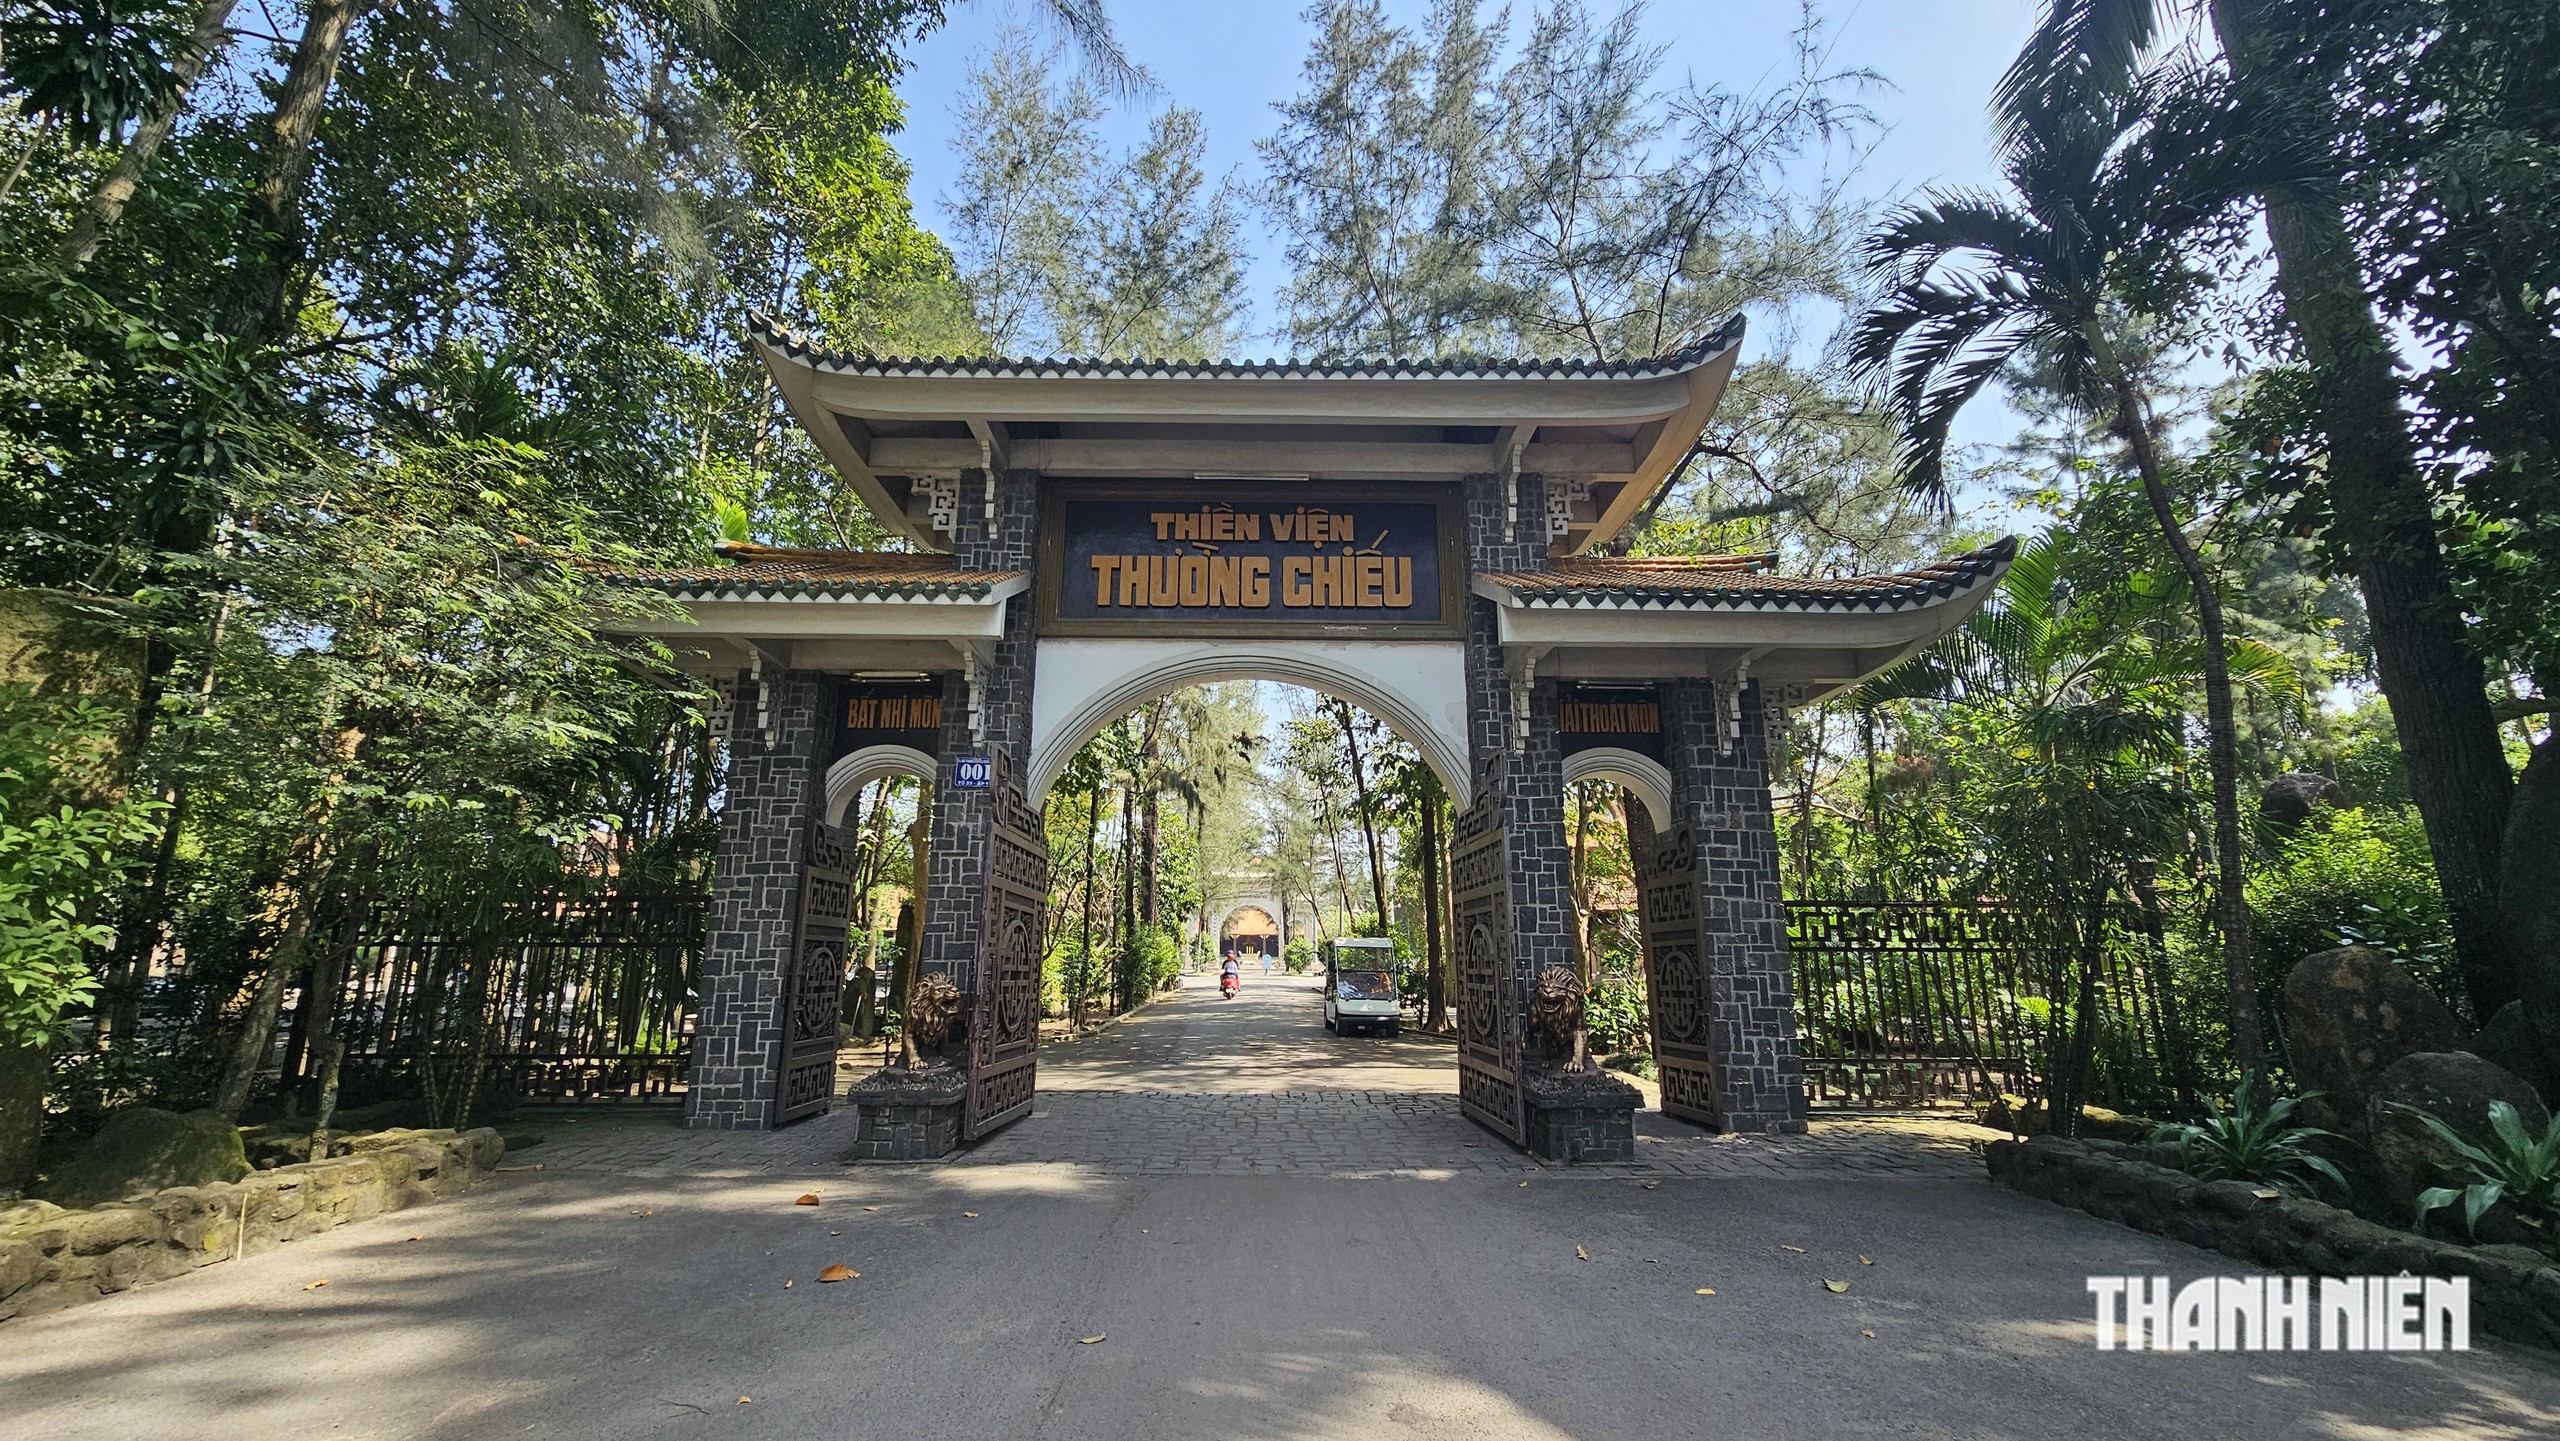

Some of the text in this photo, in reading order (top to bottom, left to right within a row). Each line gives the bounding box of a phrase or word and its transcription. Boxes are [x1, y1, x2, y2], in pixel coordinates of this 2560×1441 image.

[1151, 502, 1354, 549] THIỀN VIỆN
[1091, 530, 1413, 607] THƯỜNG CHIẾU
[847, 688, 942, 732] BẤT NHỊ MÔN
[1559, 694, 1660, 734] IẢI THOÁT MÔN
[960, 763, 991, 781] 001
